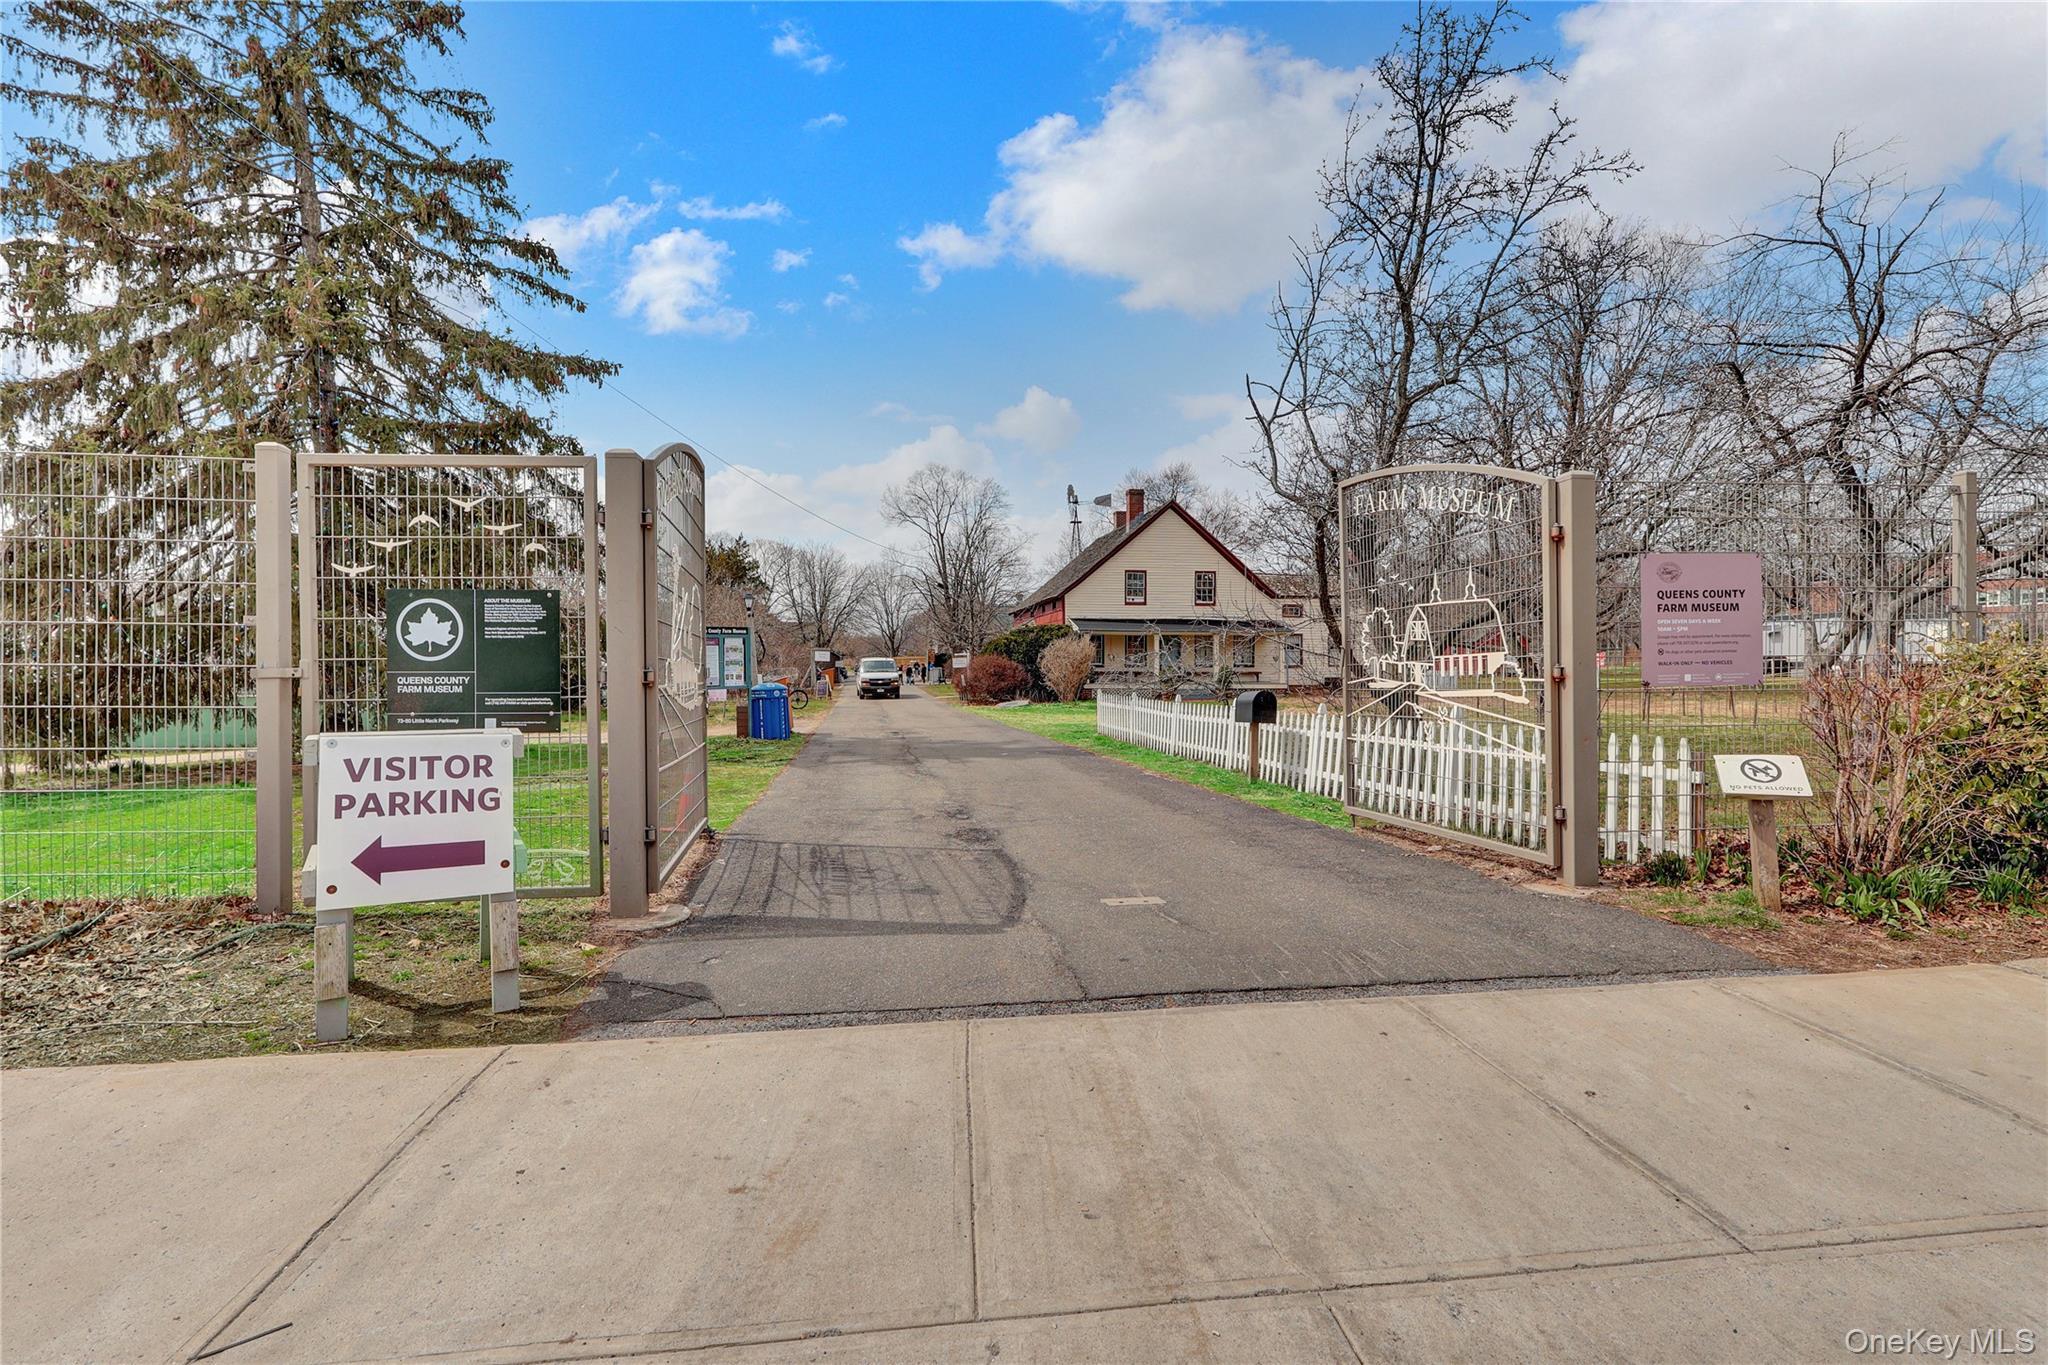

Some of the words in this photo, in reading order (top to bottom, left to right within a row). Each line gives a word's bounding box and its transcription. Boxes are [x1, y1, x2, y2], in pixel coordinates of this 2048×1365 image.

[1354, 485, 1407, 516] FARM
[1418, 485, 1516, 523] MUSEUM
[1657, 589, 1699, 600] QUEENS
[1702, 589, 1746, 598] COUNTY
[1657, 603, 1688, 613] FARM
[1691, 603, 1740, 612] MUSEUM
[397, 676, 433, 685] QUEENS
[434, 676, 470, 684] COUNTY
[397, 685, 422, 693] FARM
[423, 685, 463, 693] MUSEUM
[343, 753, 494, 783] VISITOR
[334, 787, 501, 820] PARKING
